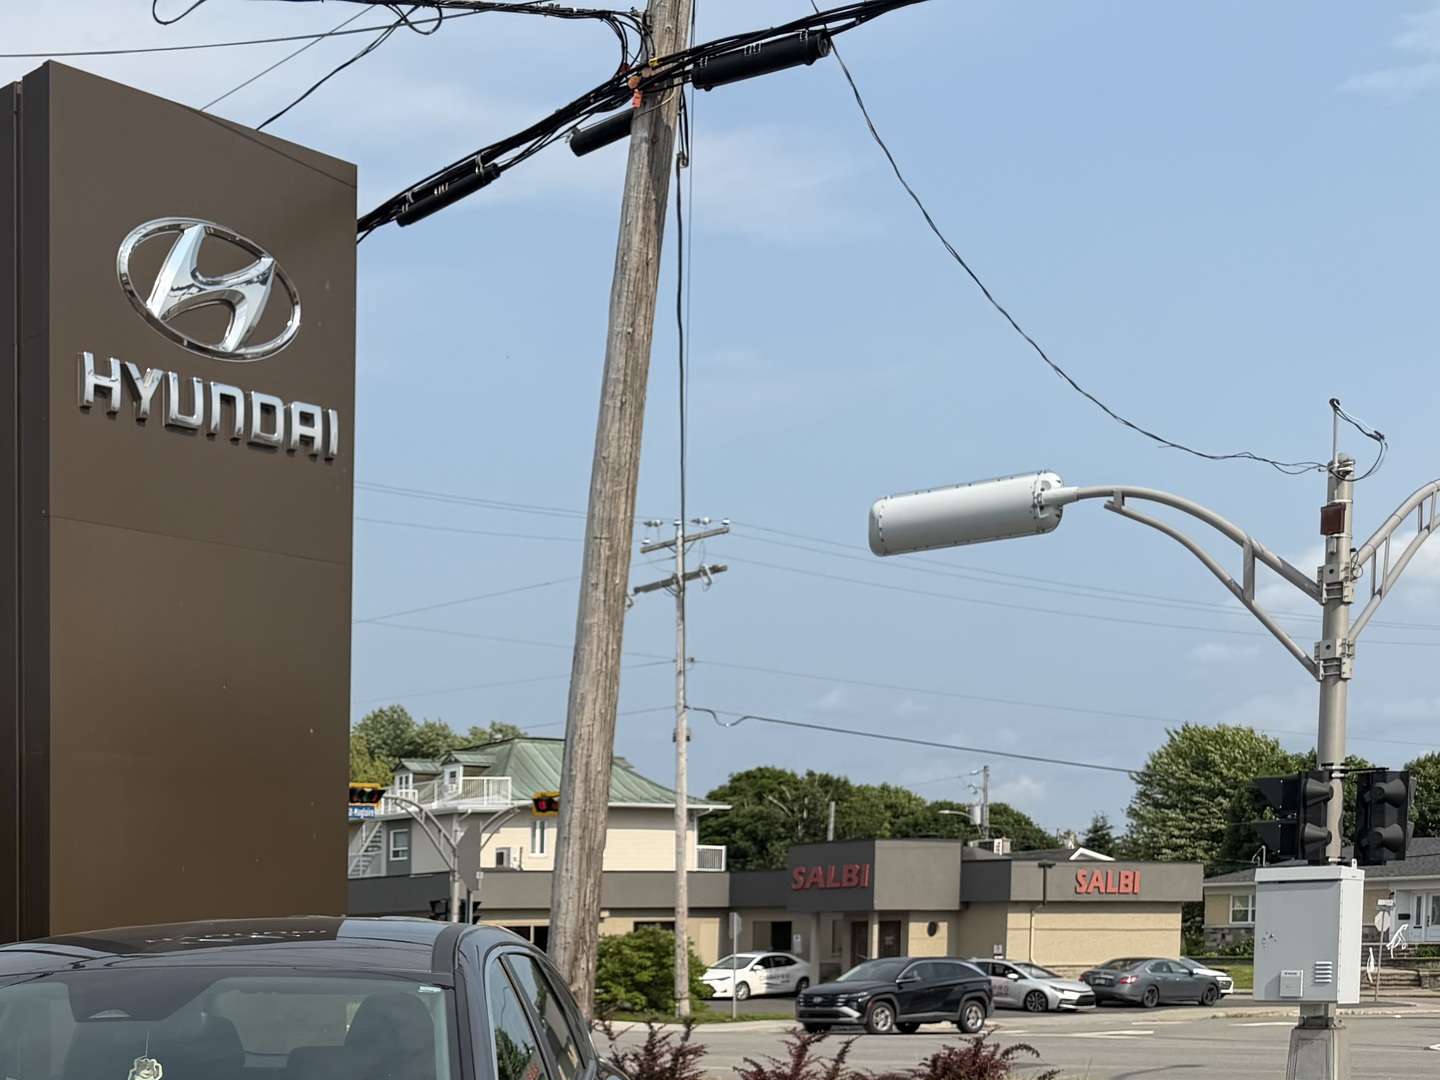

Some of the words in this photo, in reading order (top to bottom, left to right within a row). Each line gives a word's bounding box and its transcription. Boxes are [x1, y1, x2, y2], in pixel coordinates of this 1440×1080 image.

[80, 351, 339, 461] HYUNDAI
[791, 863, 870, 891] SALBI
[1074, 868, 1141, 895] SALBI
